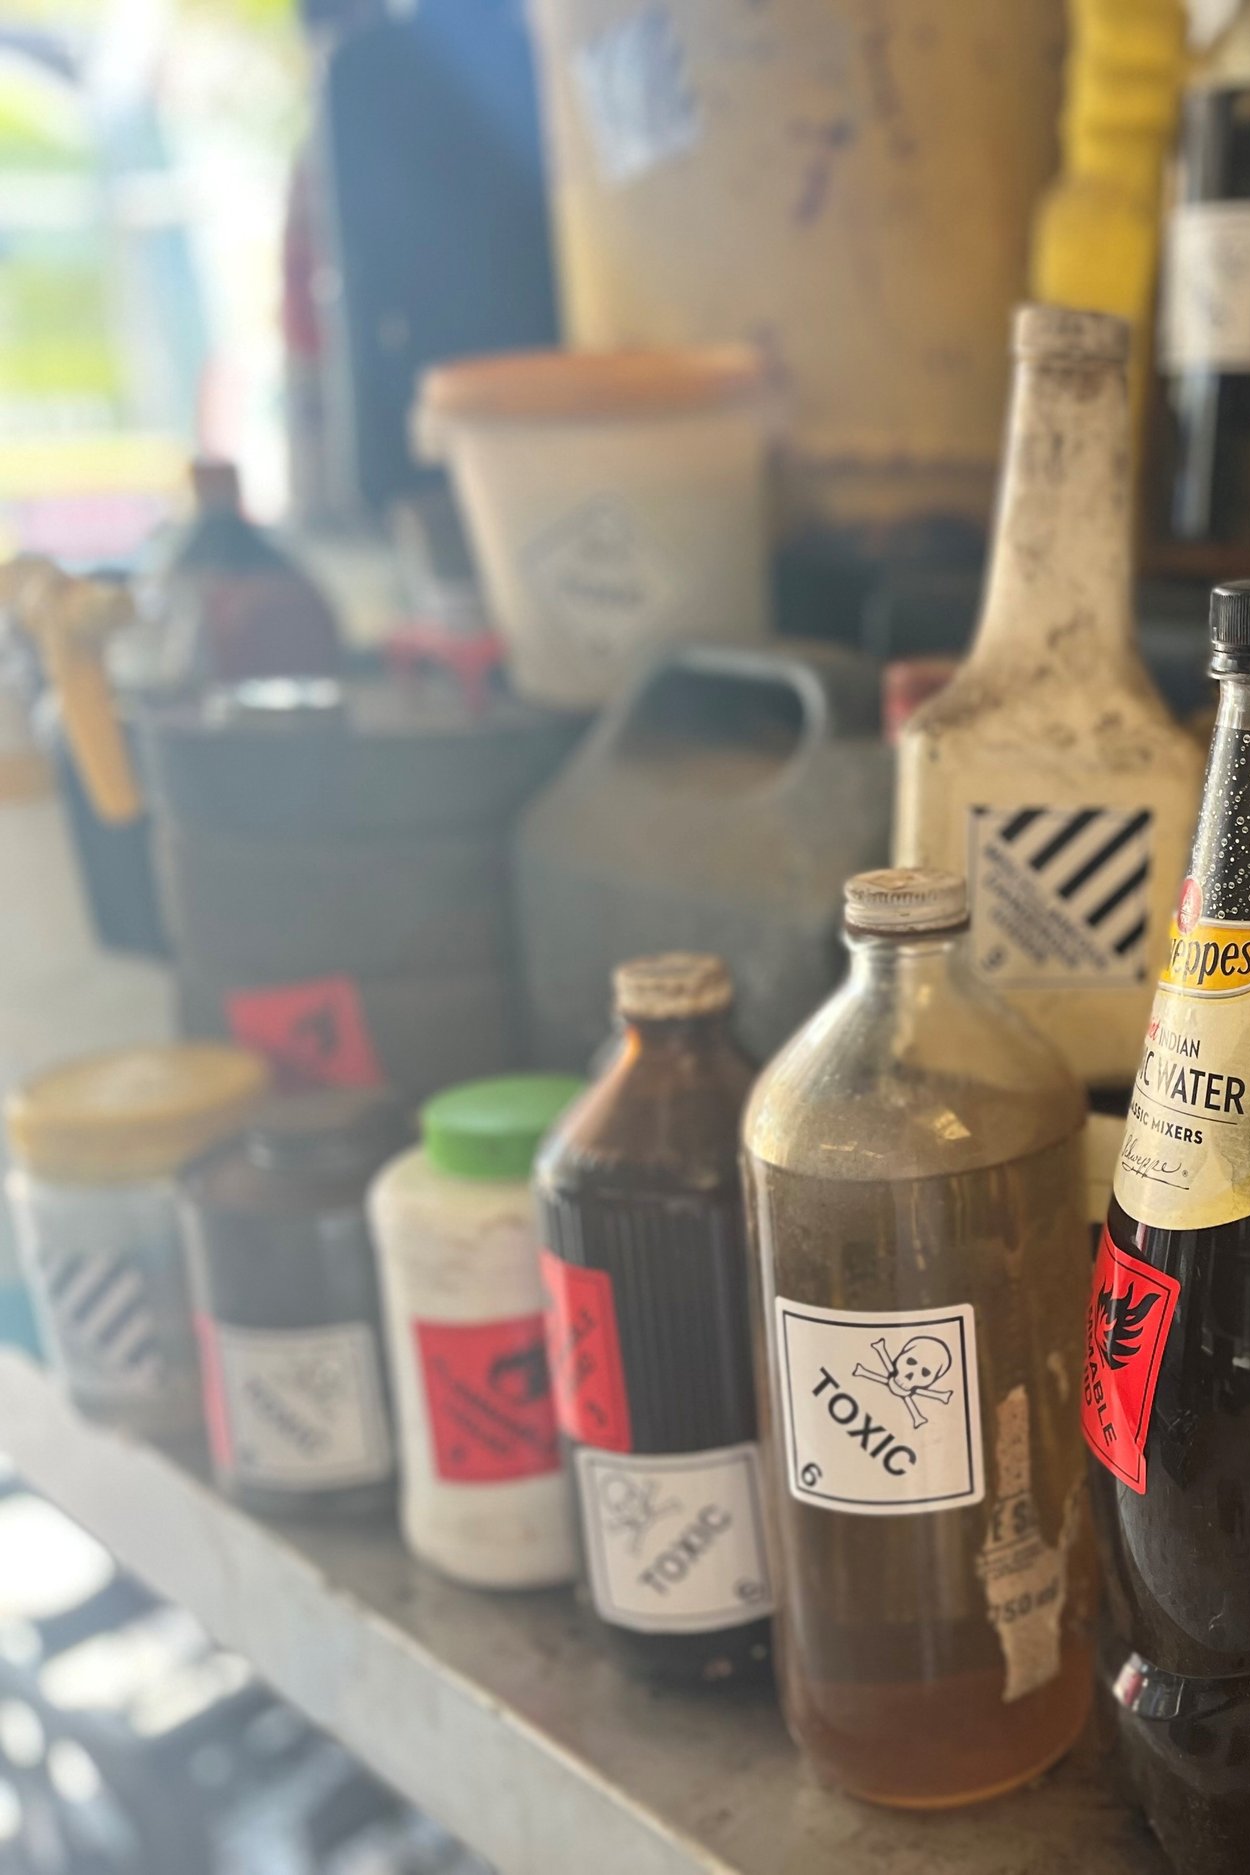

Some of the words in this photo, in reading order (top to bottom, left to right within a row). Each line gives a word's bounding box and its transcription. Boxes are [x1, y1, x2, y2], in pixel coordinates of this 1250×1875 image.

[1159, 1028, 1201, 1059] INDIAN
[1156, 1055, 1246, 1115] WATER
[1151, 1118, 1203, 1145] MIXERS
[812, 1366, 917, 1476] TOXIC
[801, 1462, 823, 1487] 6
[638, 1504, 732, 1596] TOXIC
